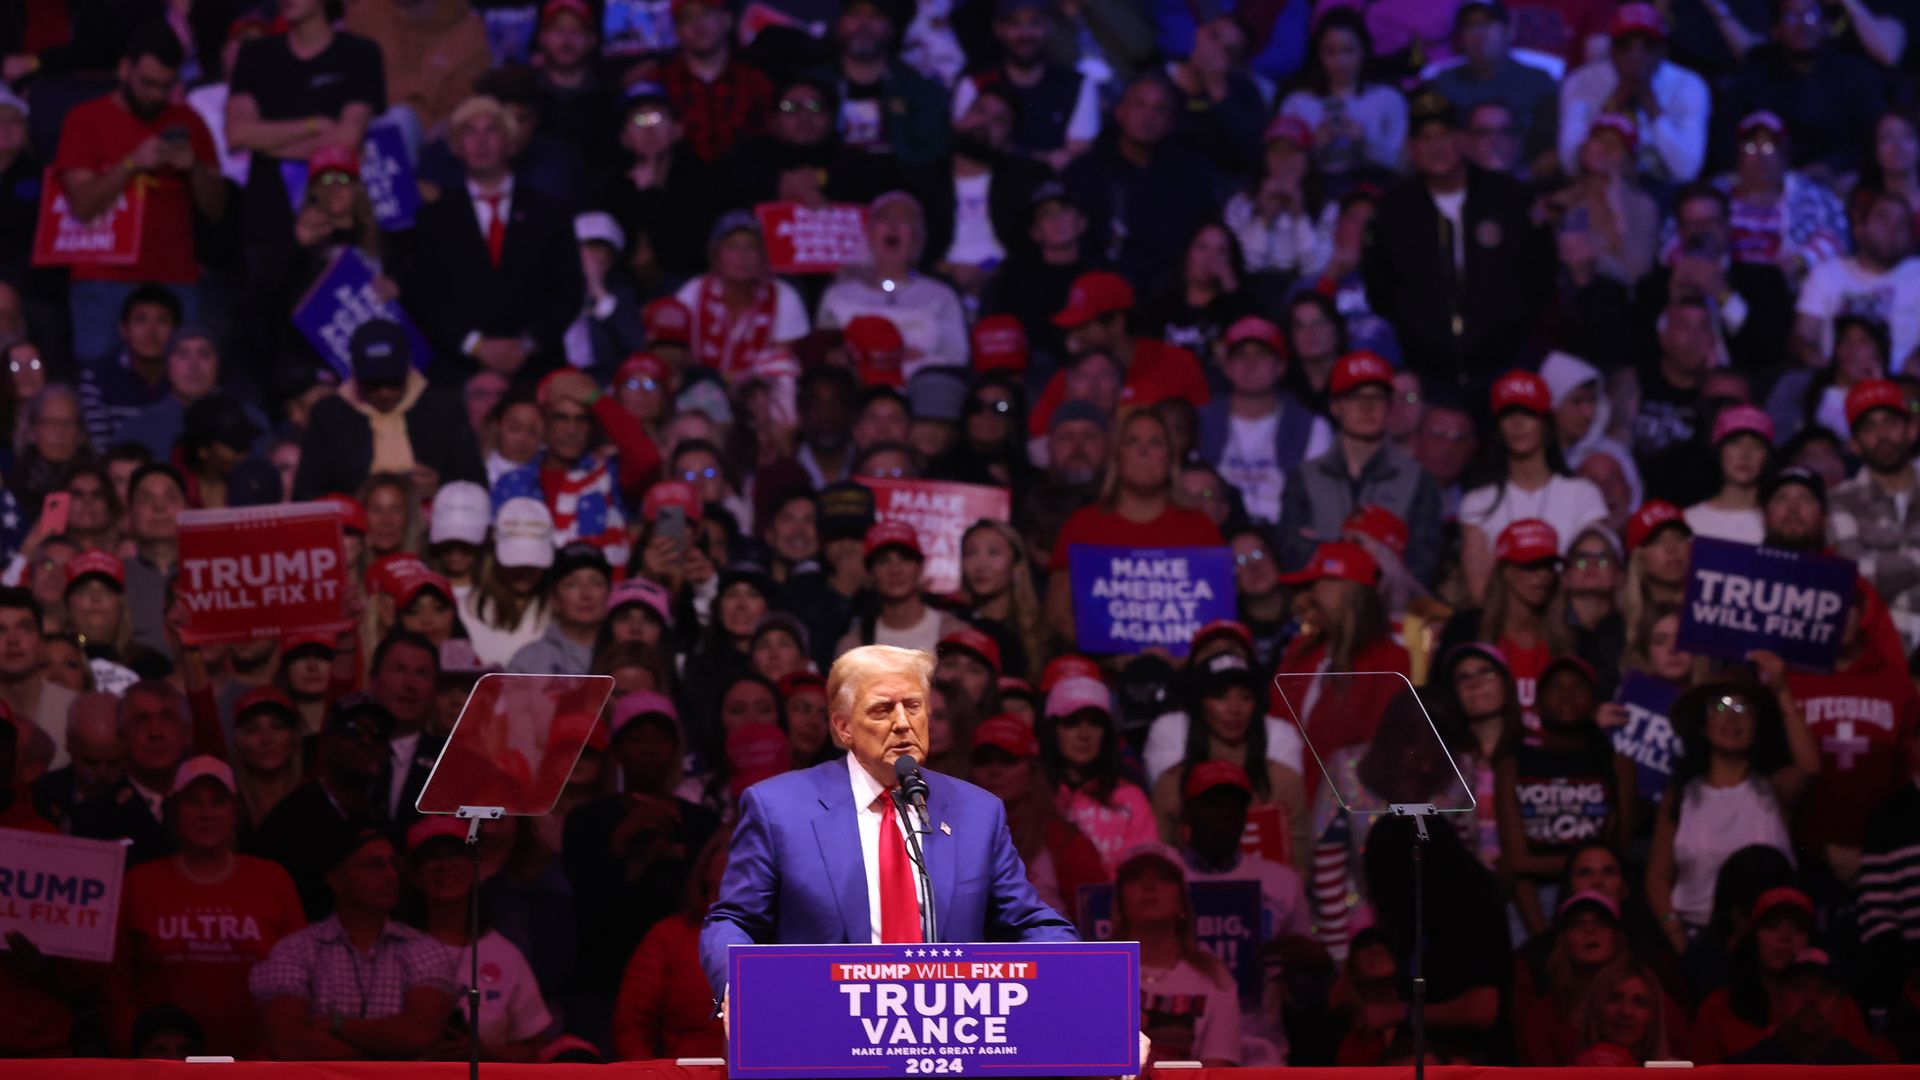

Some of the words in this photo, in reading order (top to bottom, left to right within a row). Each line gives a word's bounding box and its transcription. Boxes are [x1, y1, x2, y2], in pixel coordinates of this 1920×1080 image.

[184, 547, 337, 591] TRUMP
[1110, 557, 1190, 579] MAKE
[187, 588, 257, 612] WILL
[261, 583, 306, 607] FIX
[313, 579, 339, 600] IT
[1091, 576, 1215, 601] AMERICA
[1695, 568, 1843, 622] TRUMP
[1107, 599, 1199, 621] GREAT
[1691, 600, 1759, 633] WILL
[1764, 614, 1806, 641] FIX
[1808, 623, 1836, 644] IT
[1796, 695, 1895, 731] IFEGUARD
[1612, 731, 1673, 775] WILL
[1515, 783, 1605, 804] VOTING
[0, 868, 105, 907] RUMP
[30, 903, 69, 927] FIX
[78, 909, 101, 930] IT
[157, 914, 262, 941] ULTRA
[1197, 915, 1251, 939] BIG,
[840, 964, 911, 979] TRUMP
[916, 963, 965, 978] WILL
[971, 963, 1003, 978] FIX
[1009, 963, 1028, 978] IT
[839, 982, 1029, 1016] TRUMP
[861, 1016, 1008, 1044] VANCE
[852, 1047, 883, 1056] MAKE
[886, 1047, 936, 1056] AMERICA
[939, 1047, 975, 1055] GREAT
[978, 1046, 1018, 1055] AGAIN!
[905, 1057, 964, 1074] 2024
